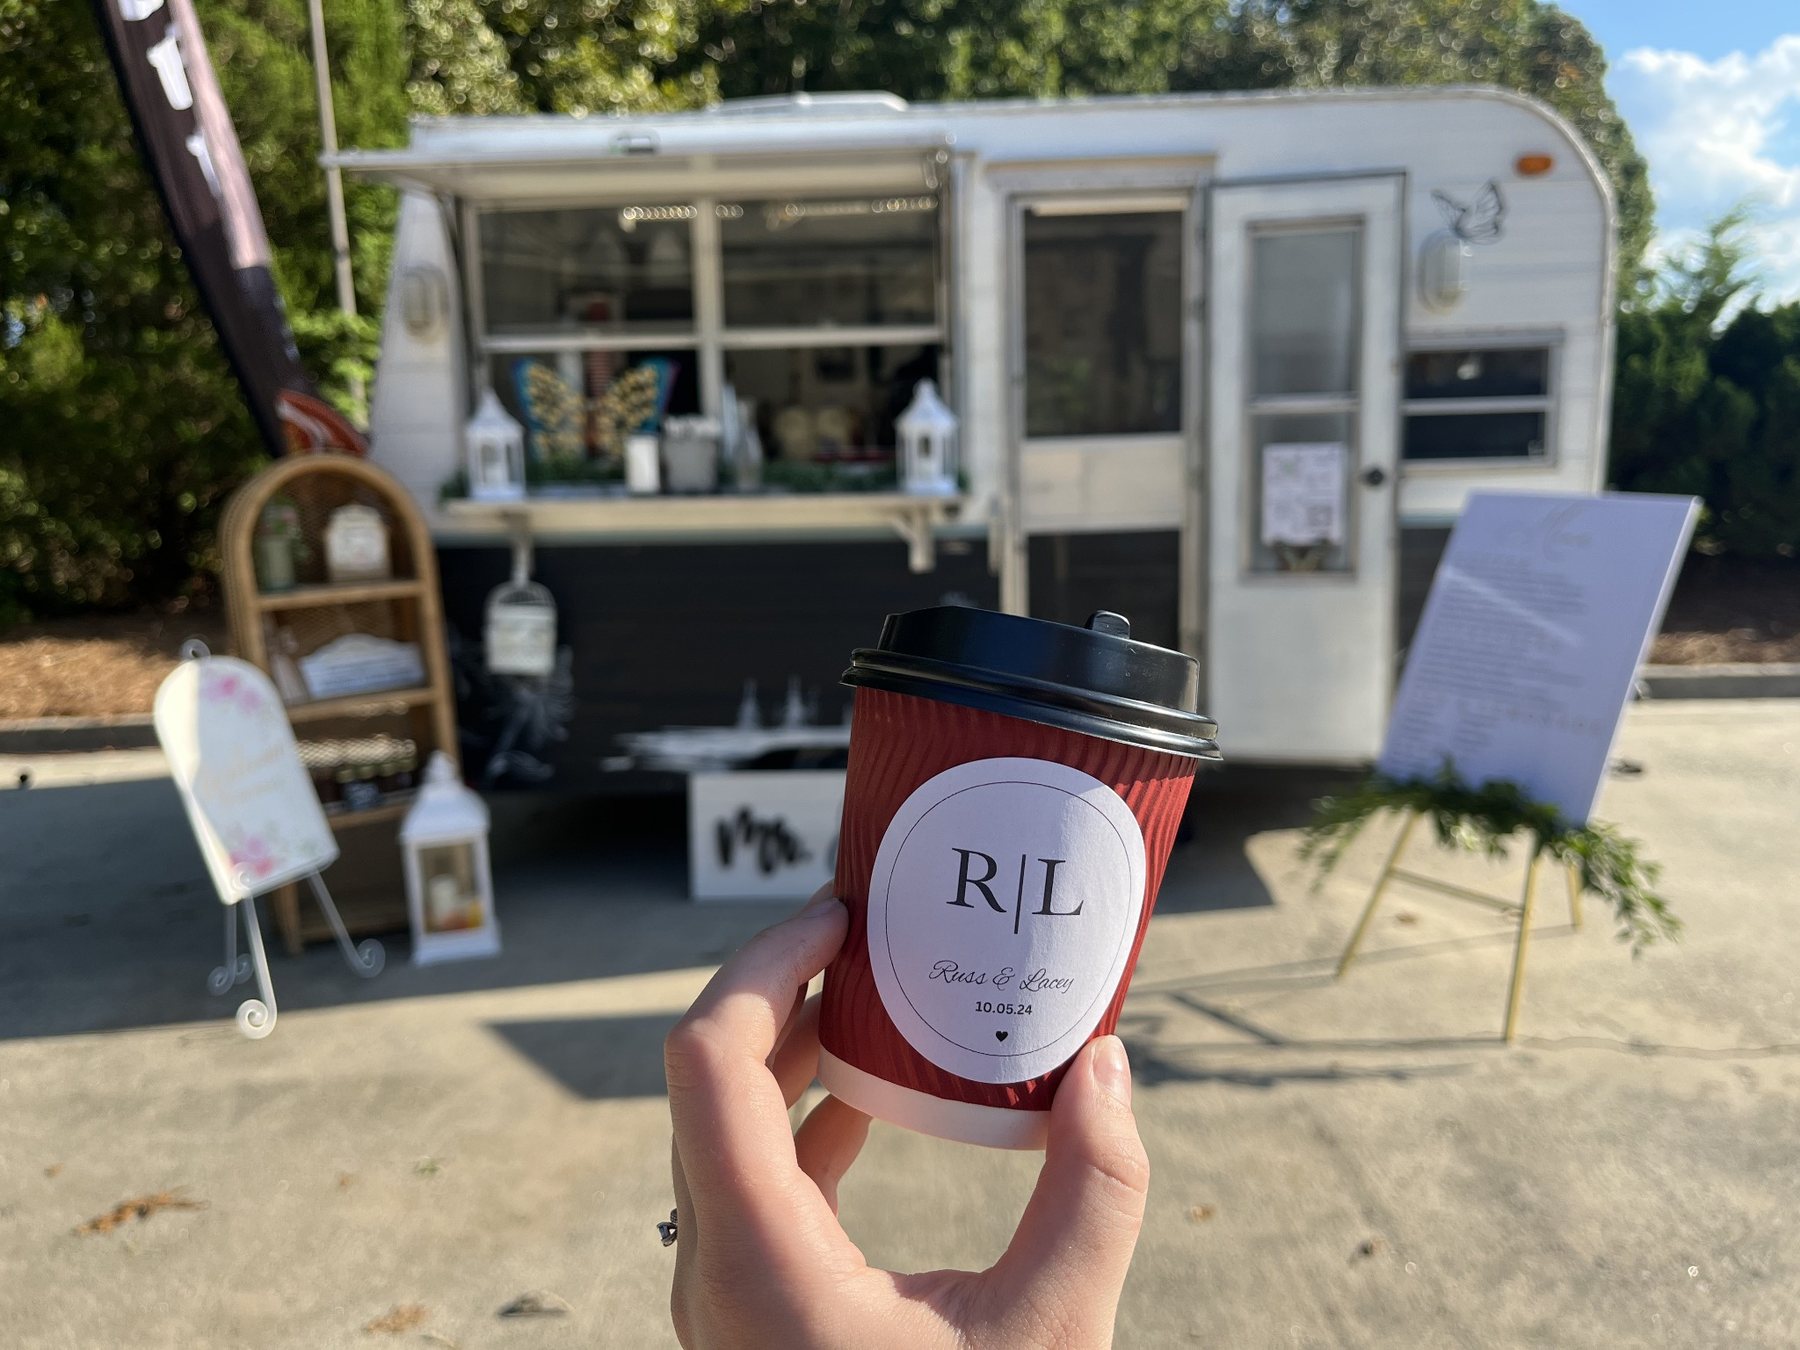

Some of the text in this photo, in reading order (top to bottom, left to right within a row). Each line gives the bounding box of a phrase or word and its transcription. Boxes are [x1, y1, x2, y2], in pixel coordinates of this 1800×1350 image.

[928, 960, 1075, 994] Russ & Lacey
[975, 1001, 1033, 1016] 10.05.24
